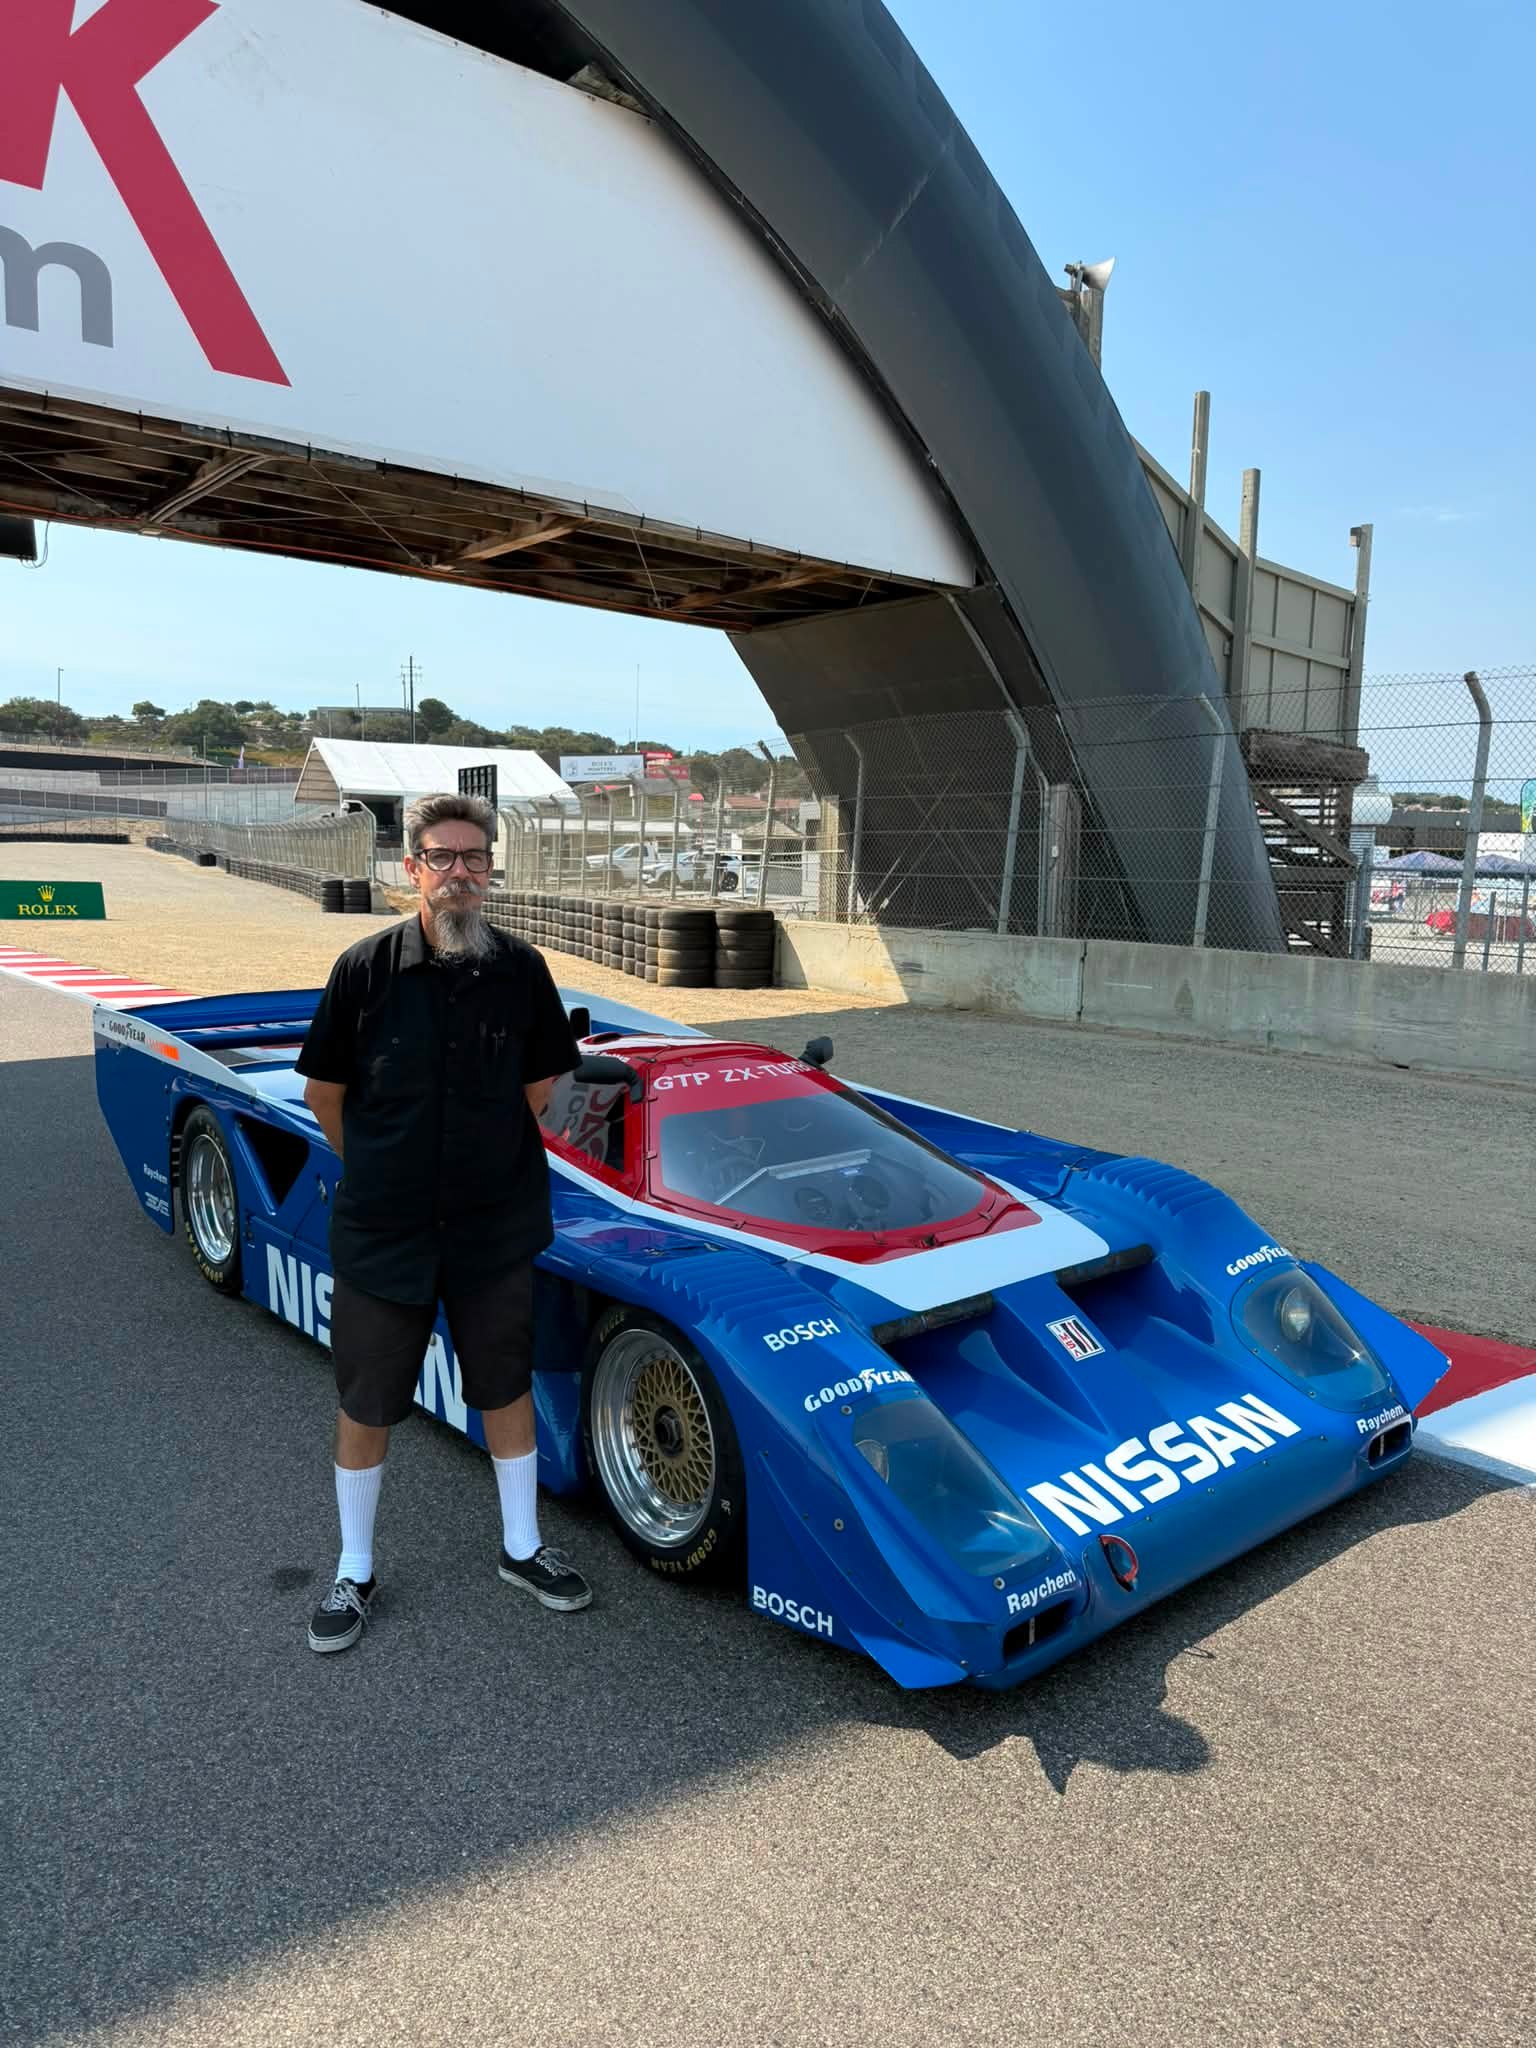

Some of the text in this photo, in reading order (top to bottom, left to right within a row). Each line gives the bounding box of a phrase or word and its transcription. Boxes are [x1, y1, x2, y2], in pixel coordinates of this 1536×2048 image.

[17, 903, 79, 916] ROLEX
[108, 1020, 146, 1044] GOODYEAR
[653, 1072, 711, 1090] GTP
[763, 1318, 841, 1352] BOSCH
[1356, 1404, 1405, 1434] Raychem
[1026, 1393, 1302, 1536] NISSAN
[1006, 1569, 1076, 1615] Raychem
[753, 1584, 833, 1637] BOSCH
